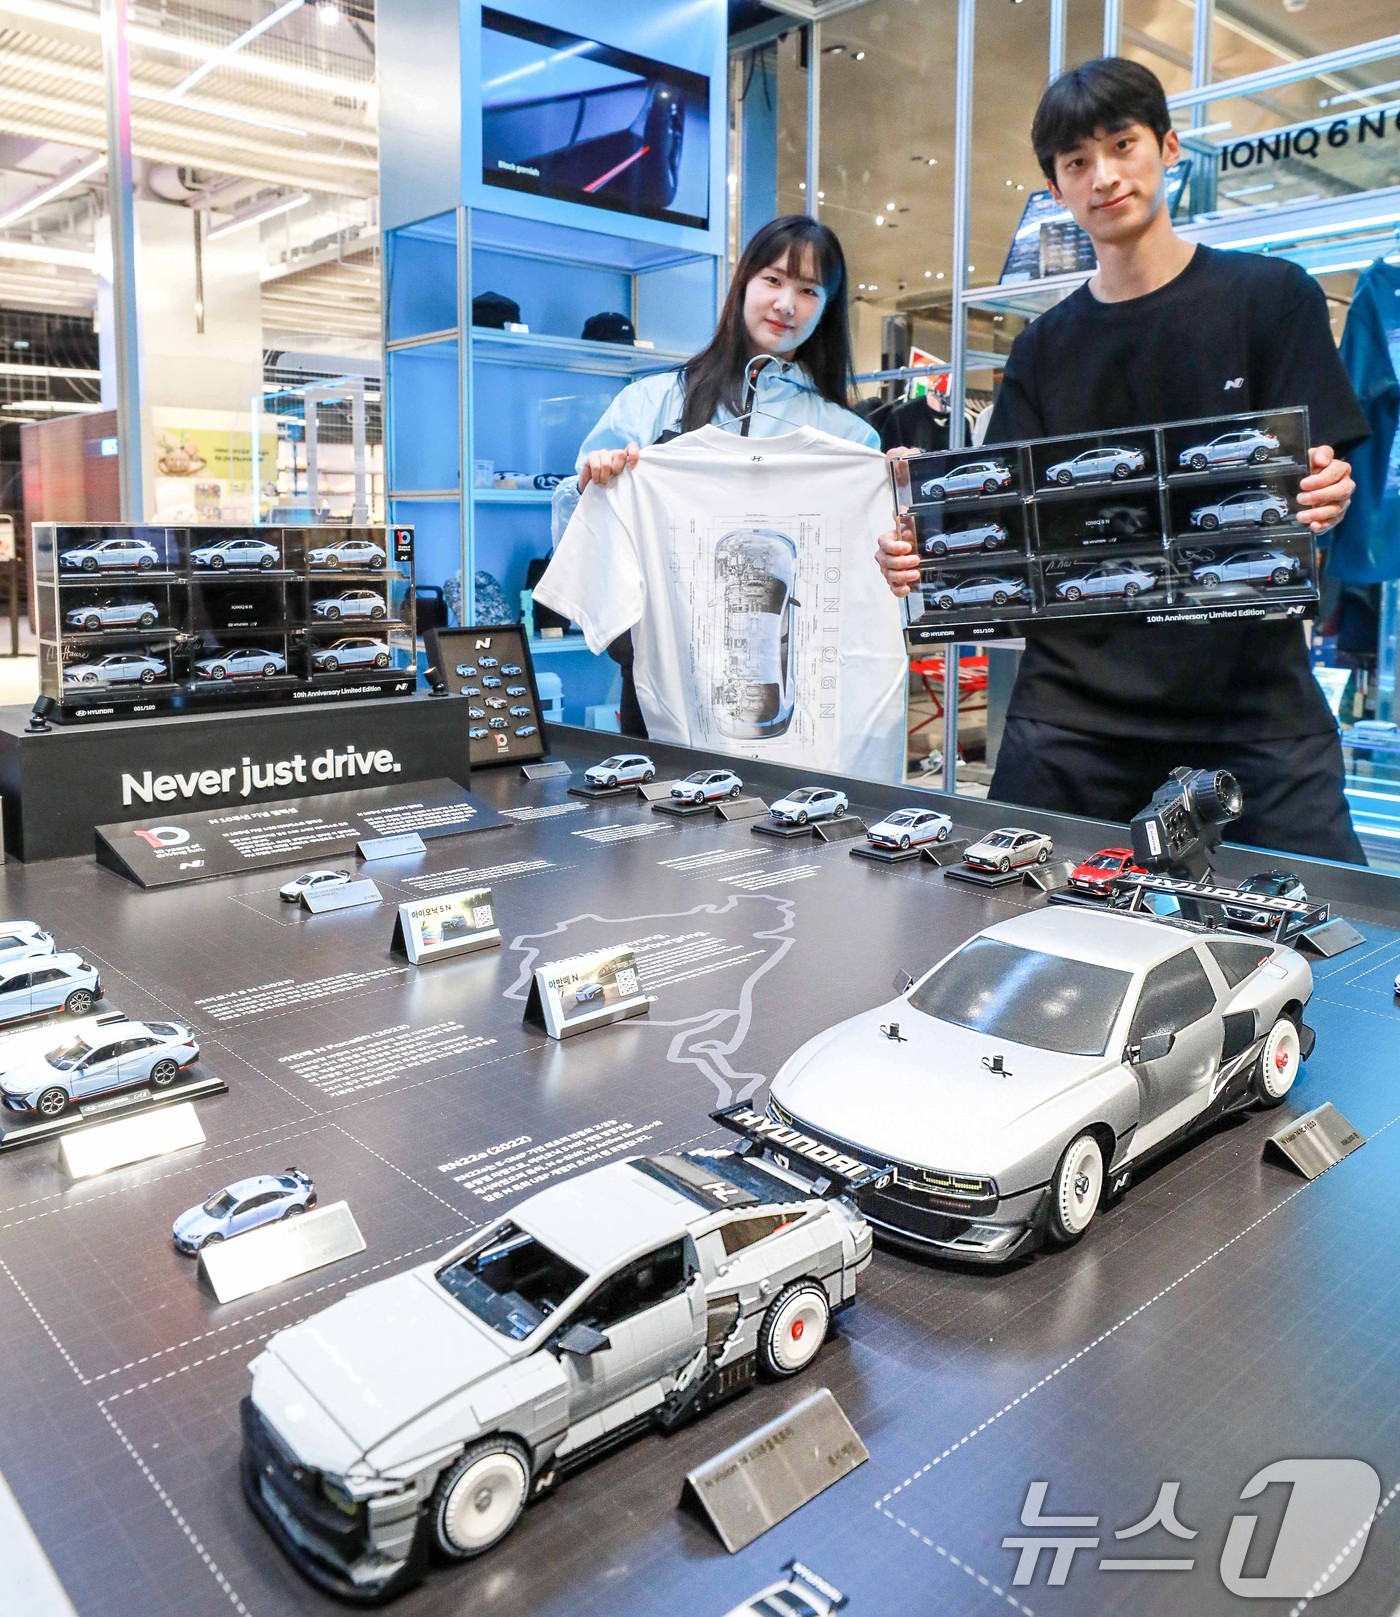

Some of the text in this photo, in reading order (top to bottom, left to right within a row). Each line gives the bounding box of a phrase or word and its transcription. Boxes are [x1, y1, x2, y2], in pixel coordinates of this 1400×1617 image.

[1222, 128, 1319, 171] IONIQ
[1327, 120, 1348, 148] 6
[1358, 110, 1385, 142] N
[1146, 608, 1265, 623] 10th Anniversary Limited Edition
[293, 690, 307, 698] 10th
[307, 690, 340, 698] Anniversary
[87, 708, 114, 716] HYUNDAI
[121, 746, 401, 806] Never just drive.
[156, 850, 187, 859] driving
[165, 846, 190, 854] years
[411, 906, 439, 919] 아이오닉
[549, 974, 579, 989] 아반떼 N
[194, 989, 237, 1005] 아이오닉
[325, 1037, 373, 1049] Facelift
[98, 1097, 129, 1109] HYUNDAI
[733, 1110, 868, 1177] HYUNDAI
[438, 1136, 532, 1170] RN22e (2022)
